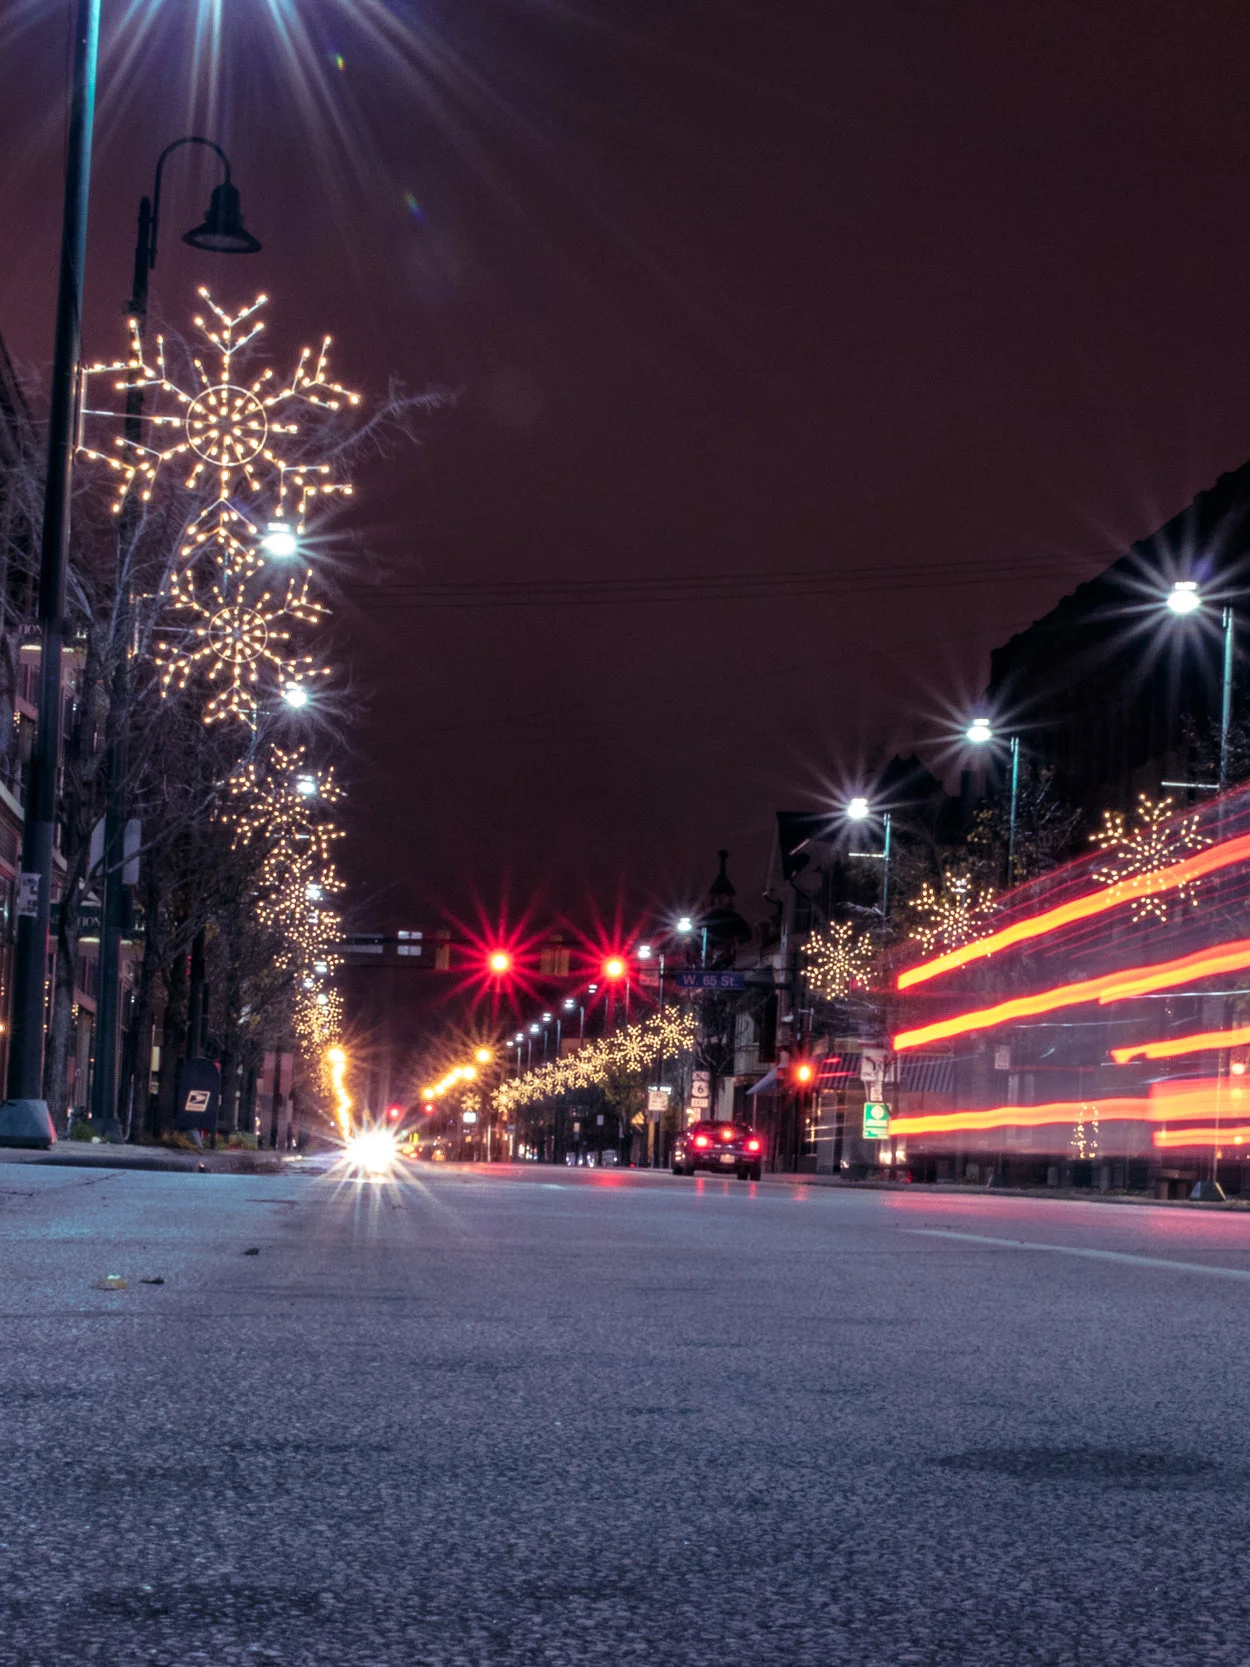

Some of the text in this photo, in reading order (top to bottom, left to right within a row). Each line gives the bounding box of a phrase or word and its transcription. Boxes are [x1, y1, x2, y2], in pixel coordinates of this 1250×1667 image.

[683, 974, 738, 987] W. 65 St.
[697, 1085, 704, 1094] 6
